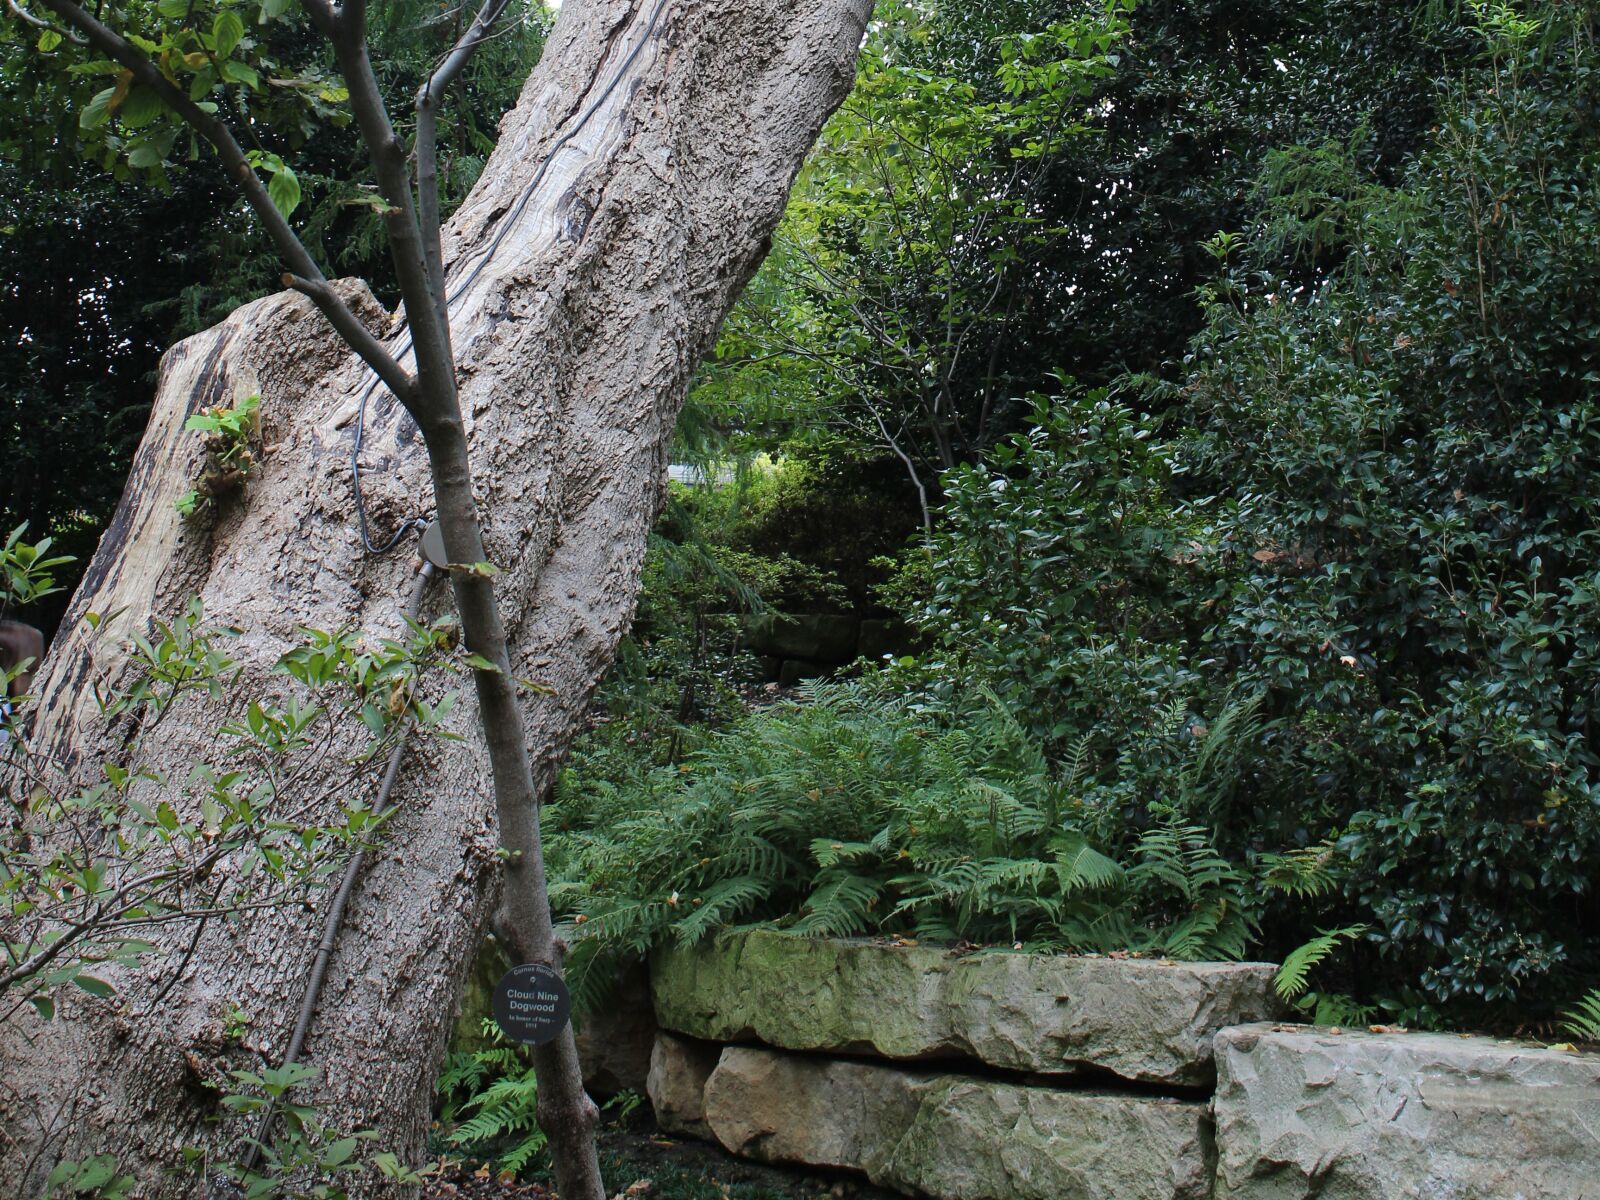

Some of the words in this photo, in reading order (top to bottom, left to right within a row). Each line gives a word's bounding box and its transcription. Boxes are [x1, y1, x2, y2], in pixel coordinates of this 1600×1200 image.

[507, 989, 535, 999] Cloud
[537, 991, 559, 1001] Nine
[510, 1000, 555, 1012] Dogwood
